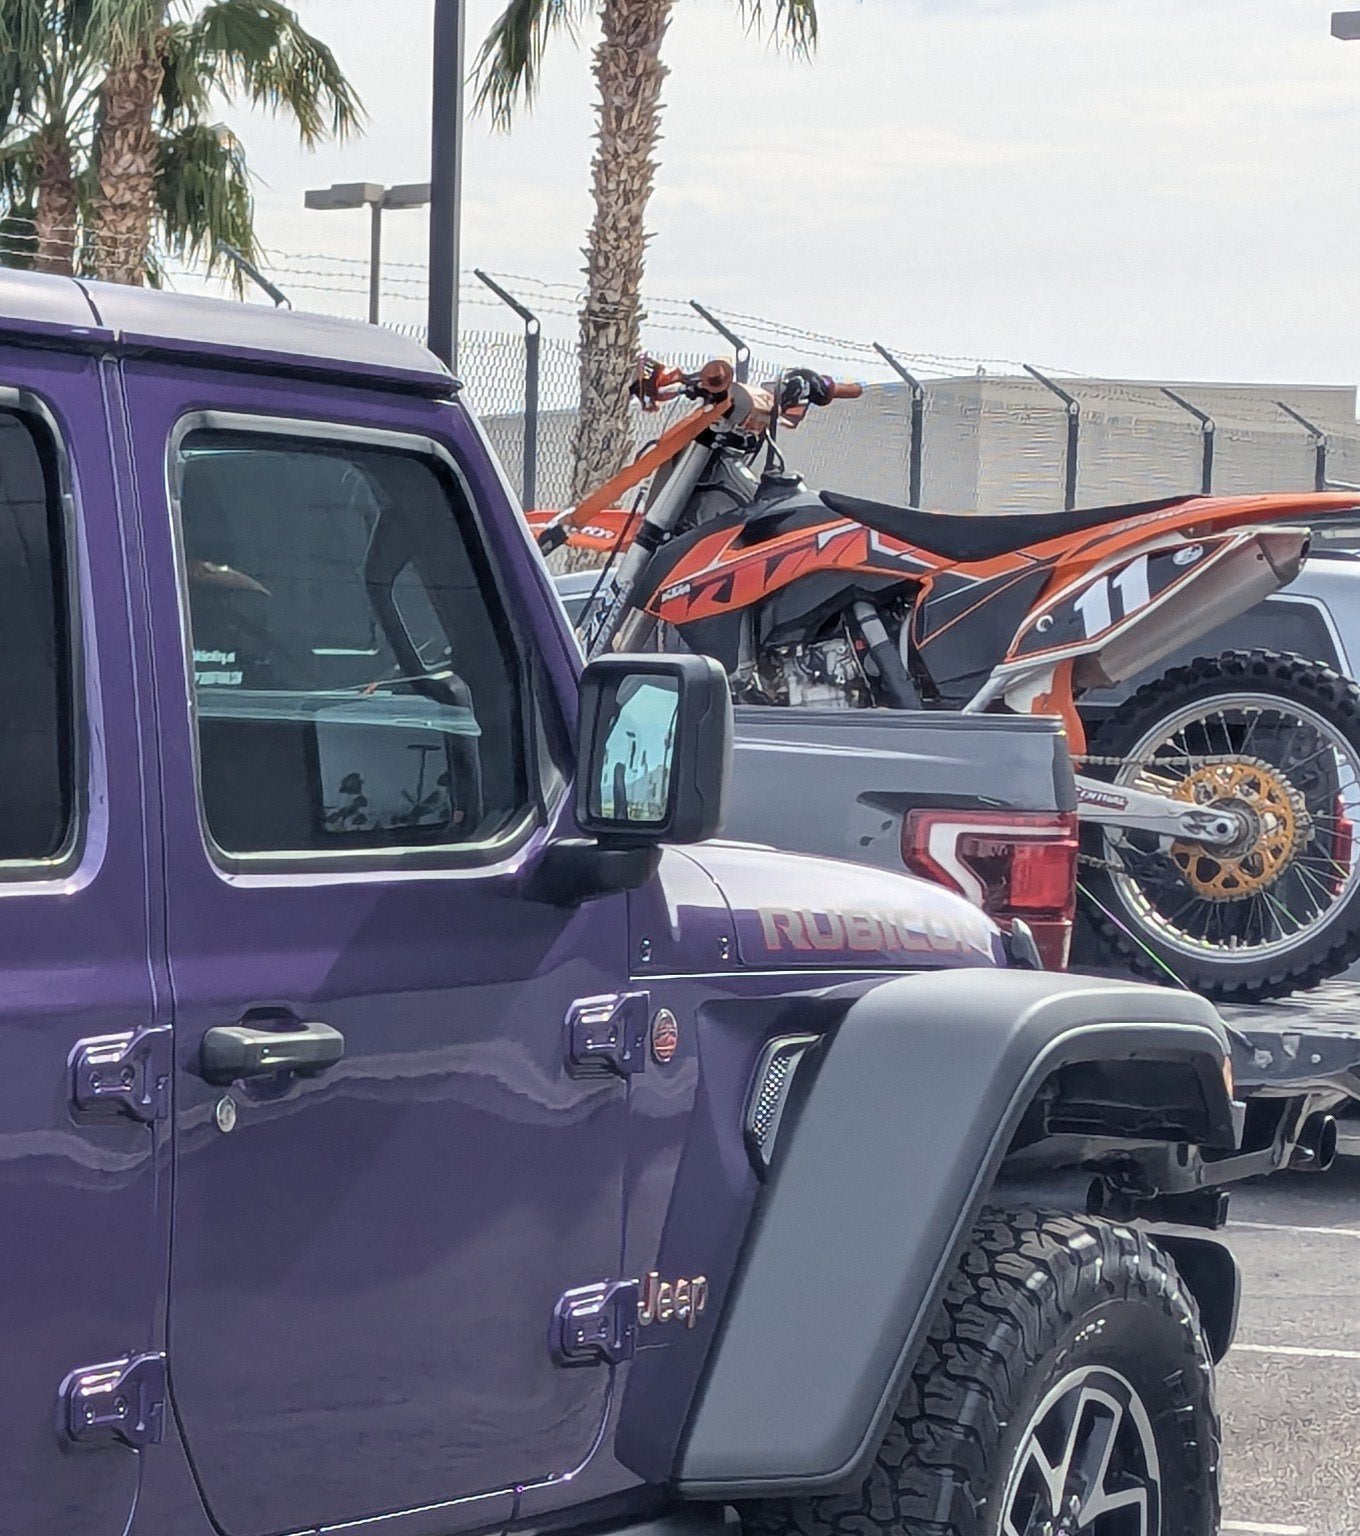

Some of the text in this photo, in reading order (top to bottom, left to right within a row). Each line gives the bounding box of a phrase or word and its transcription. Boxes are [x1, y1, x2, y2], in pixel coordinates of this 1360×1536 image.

[1074, 554, 1150, 640] 11
[758, 906, 992, 951] RUBICON
[637, 1271, 708, 1328] Jeep
